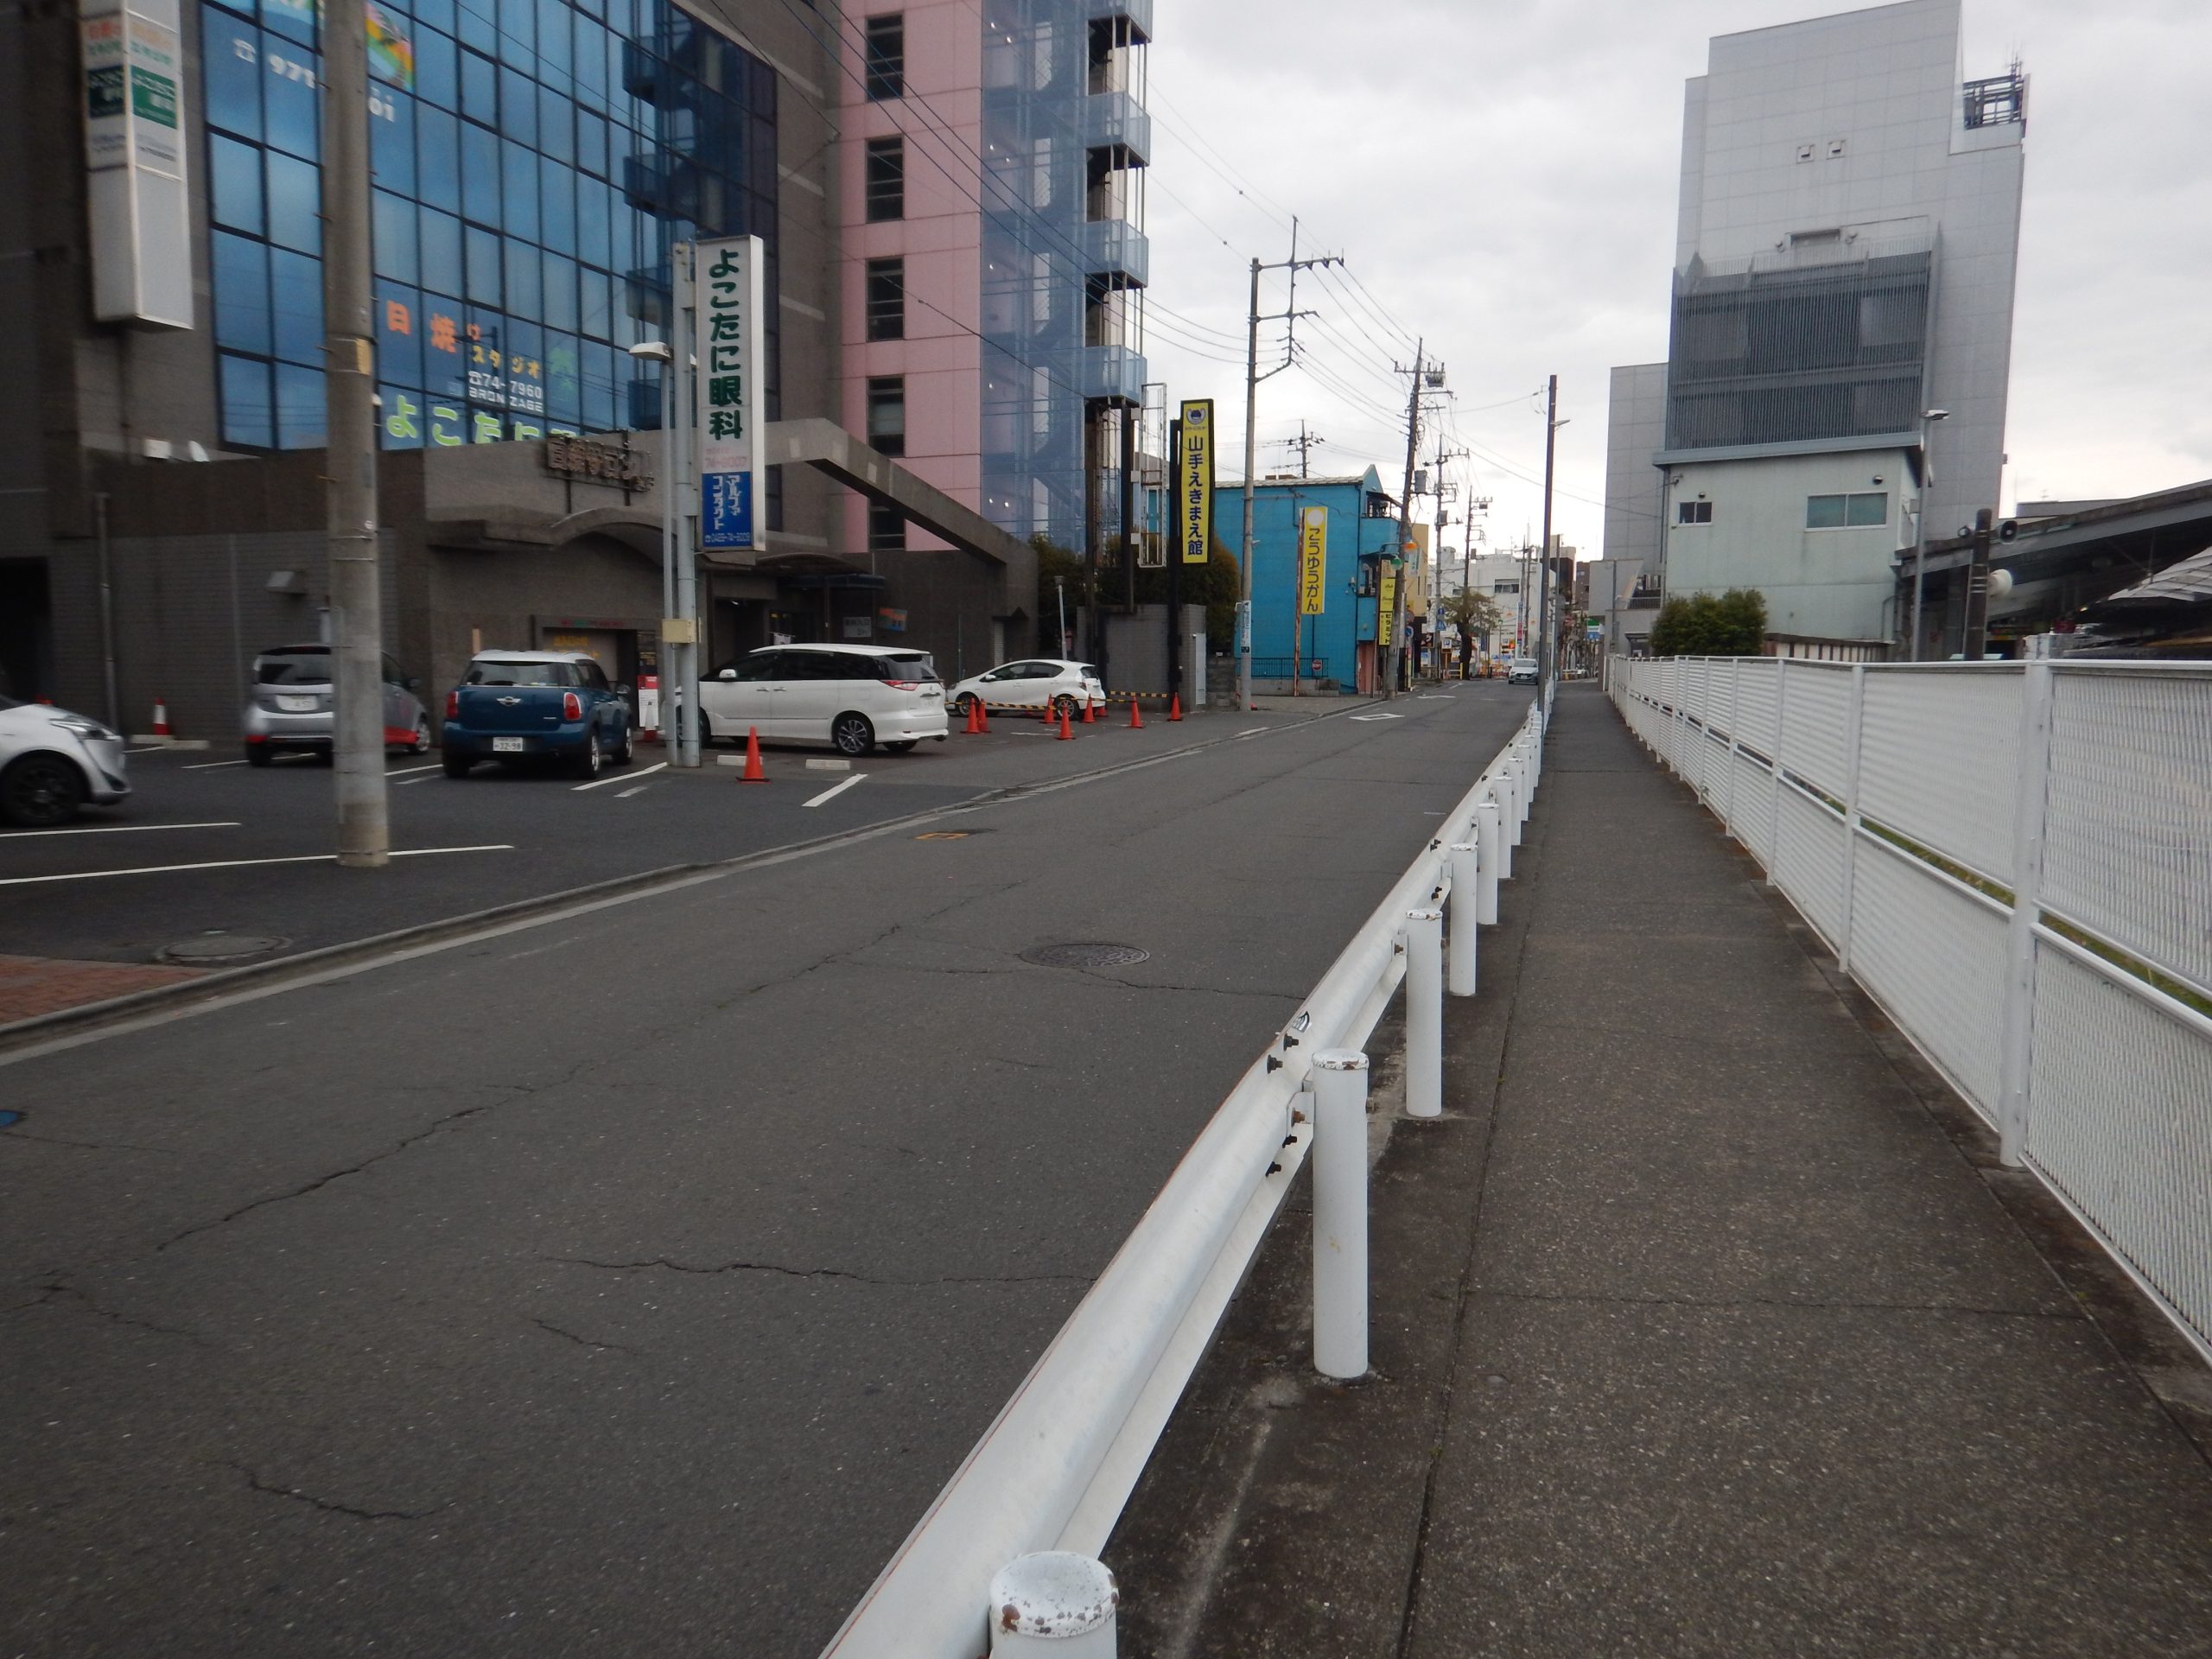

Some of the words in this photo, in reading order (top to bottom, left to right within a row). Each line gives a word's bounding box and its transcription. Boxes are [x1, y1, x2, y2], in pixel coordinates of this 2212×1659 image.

[471, 345, 541, 379] スタジオ
[709, 248, 743, 440] よこたに眼科
[712, 475, 725, 531] コンタクト
[1186, 435, 1204, 556] 山手えきまえ館
[1306, 527, 1320, 613] こうゆうかん
